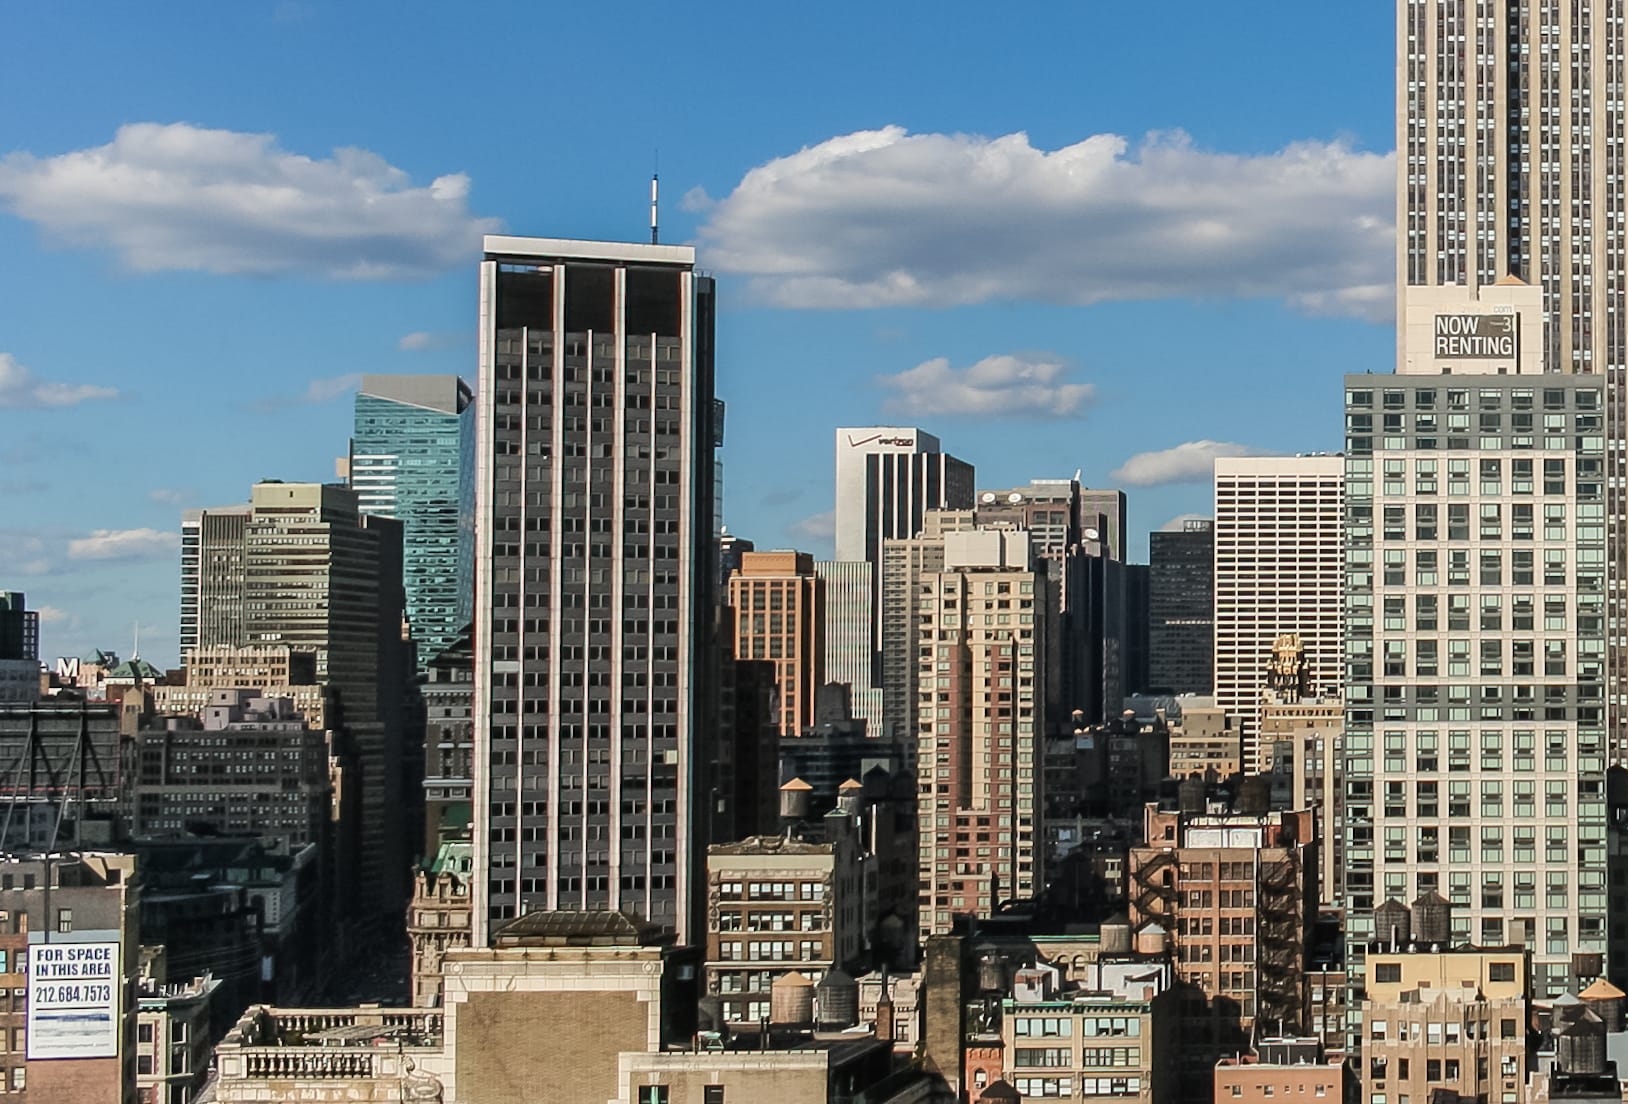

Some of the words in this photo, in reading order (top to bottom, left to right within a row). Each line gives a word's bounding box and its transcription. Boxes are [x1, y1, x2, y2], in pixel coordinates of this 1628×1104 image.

[1436, 316, 1479, 335] NOW
[1436, 336, 1513, 355] RENTING
[57, 656, 80, 677] M
[37, 949, 63, 962] FOR
[67, 948, 111, 961] SPACE
[36, 964, 49, 977] IN
[51, 963, 78, 976] THIS
[81, 962, 111, 976] AREA
[35, 985, 111, 1003] 212.684.7573
